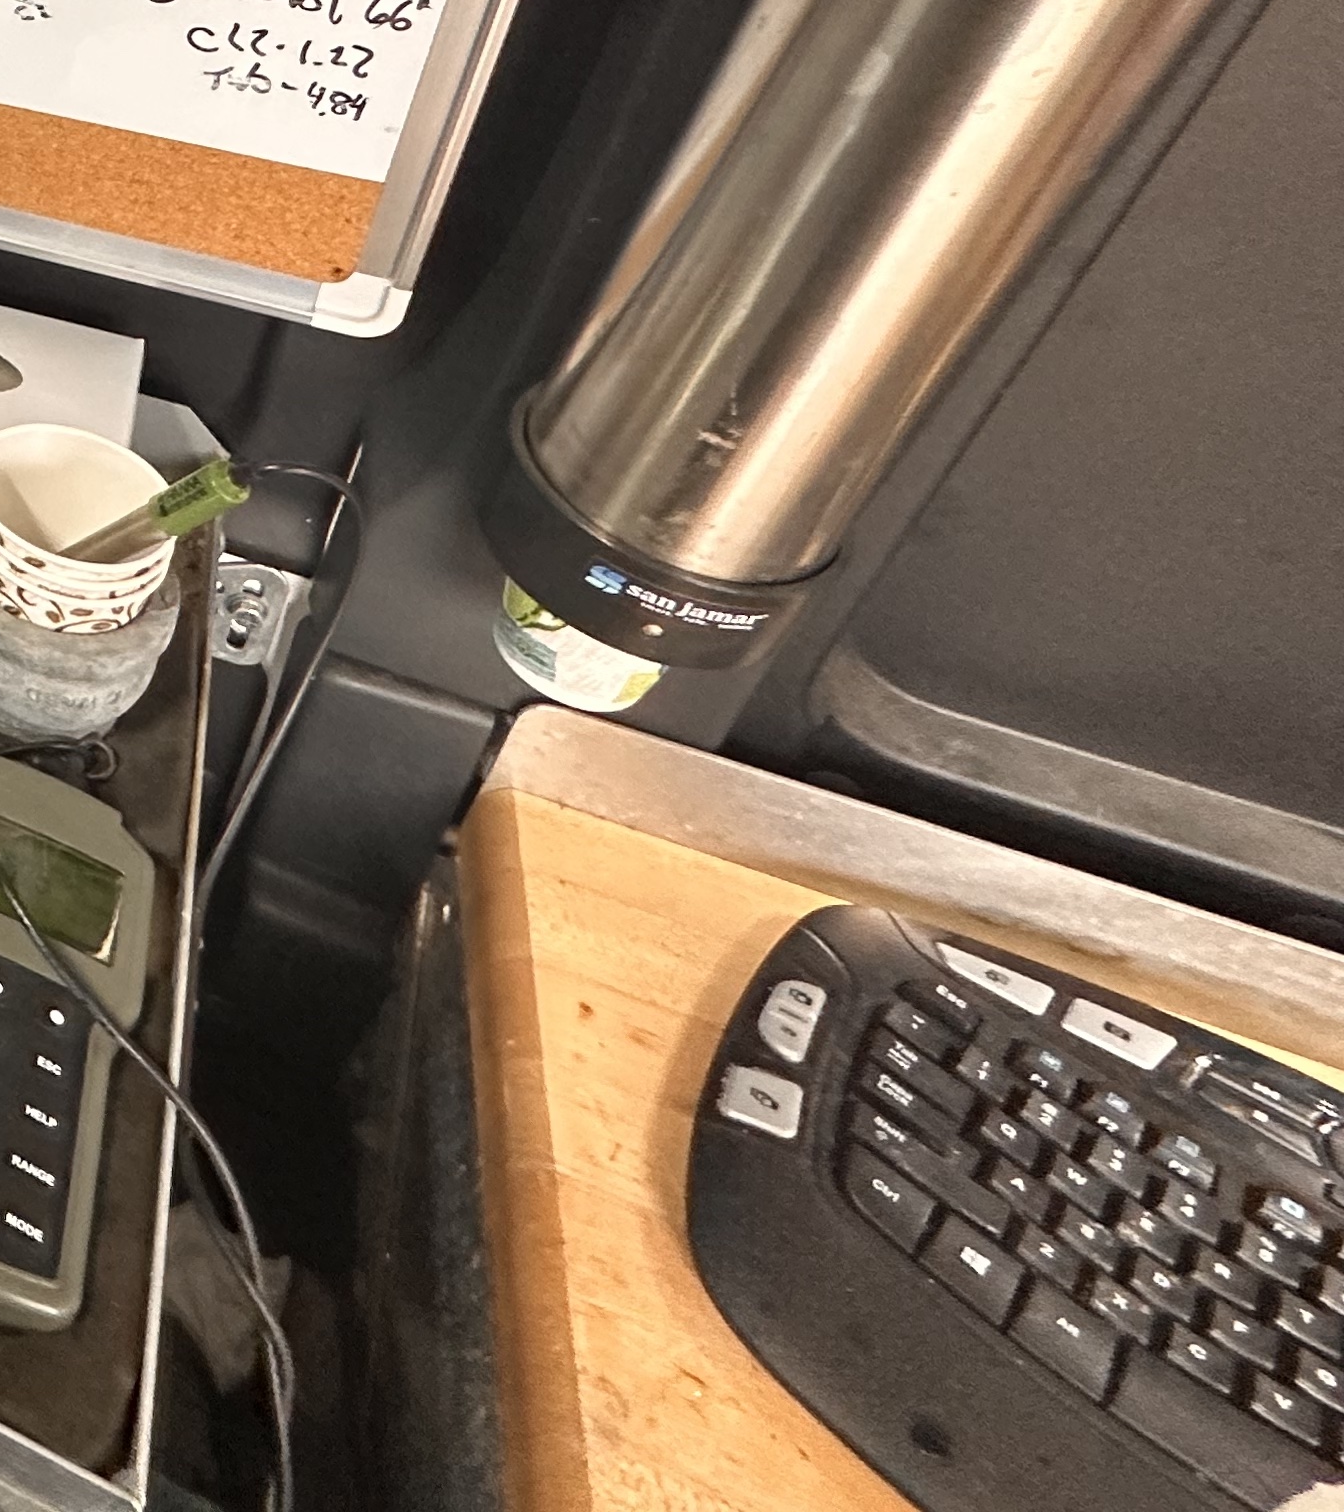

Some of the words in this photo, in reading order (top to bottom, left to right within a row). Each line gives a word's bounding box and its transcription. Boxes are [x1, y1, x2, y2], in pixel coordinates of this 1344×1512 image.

[24, 1104, 58, 1127] HELP
[11, 1153, 57, 1187] RANGE
[5, 1211, 45, 1244] MODE
